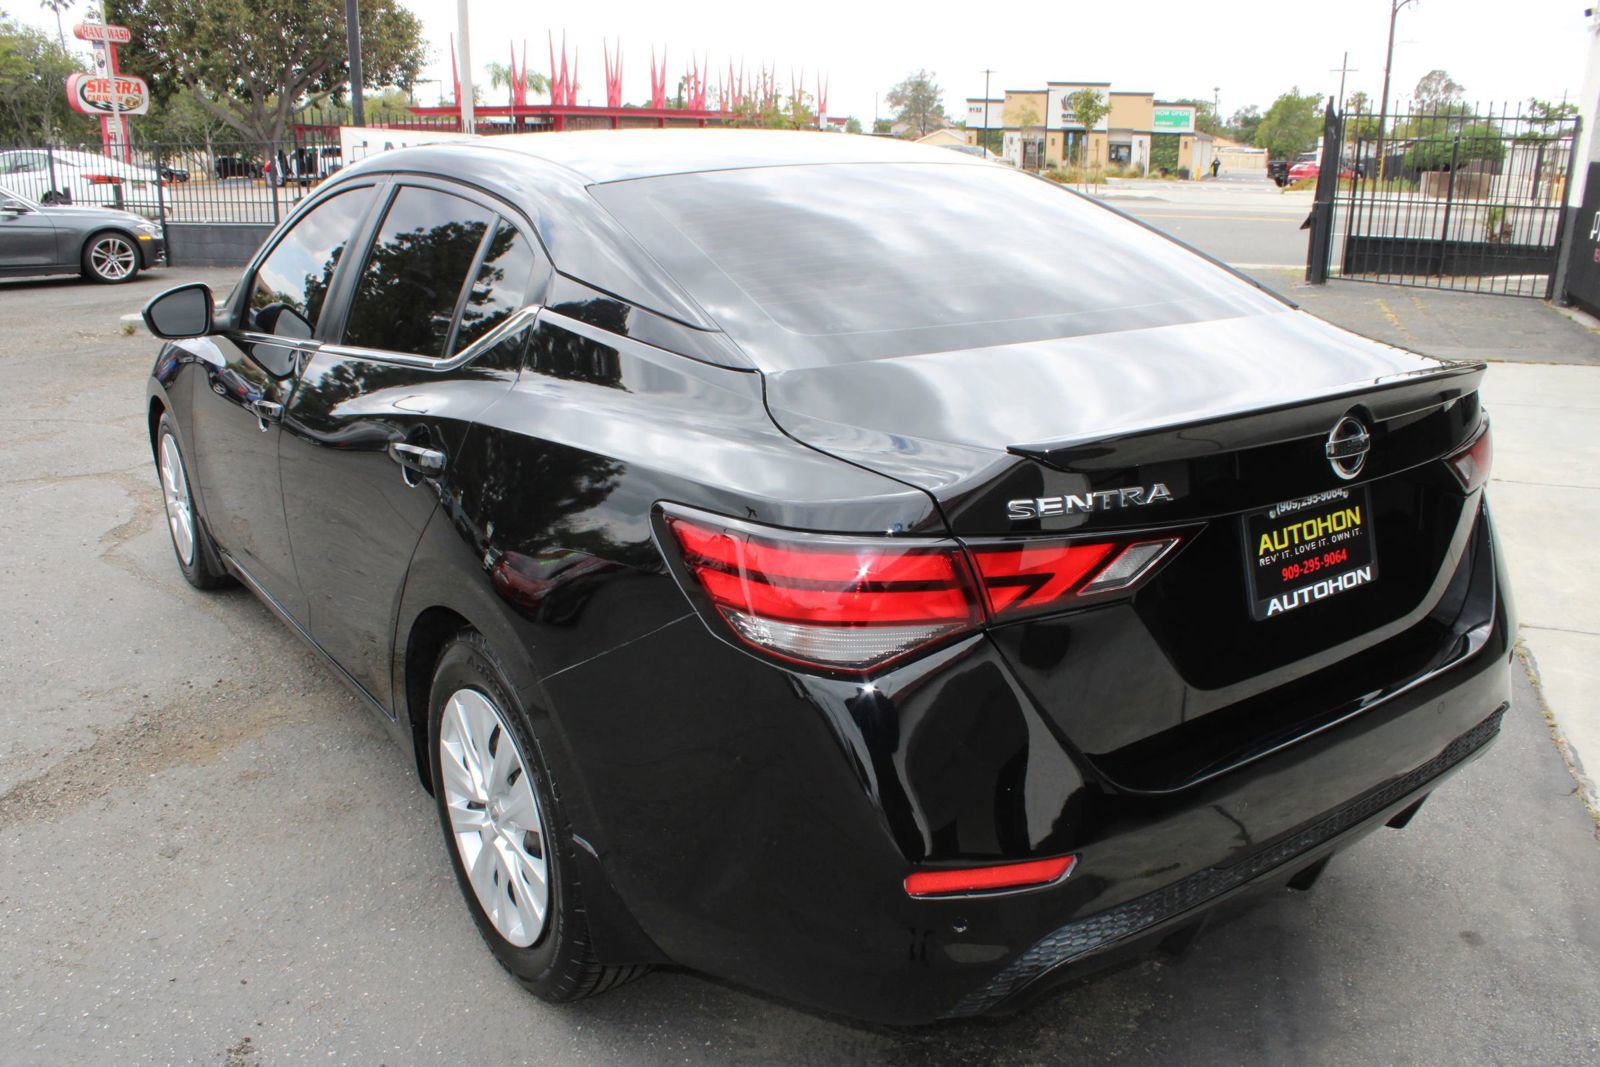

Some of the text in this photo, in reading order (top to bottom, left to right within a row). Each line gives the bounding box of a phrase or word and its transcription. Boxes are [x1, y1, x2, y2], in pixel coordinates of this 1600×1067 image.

[87, 79, 142, 95] SIERRA
[1007, 483, 1174, 520] SENTRA
[1258, 506, 1361, 556] AUTOHON
[1295, 541, 1317, 555] LOVE
[1331, 530, 1350, 543] OWN
[1281, 547, 1348, 582] 909-295-9064
[1267, 566, 1371, 616] AUTOHON
